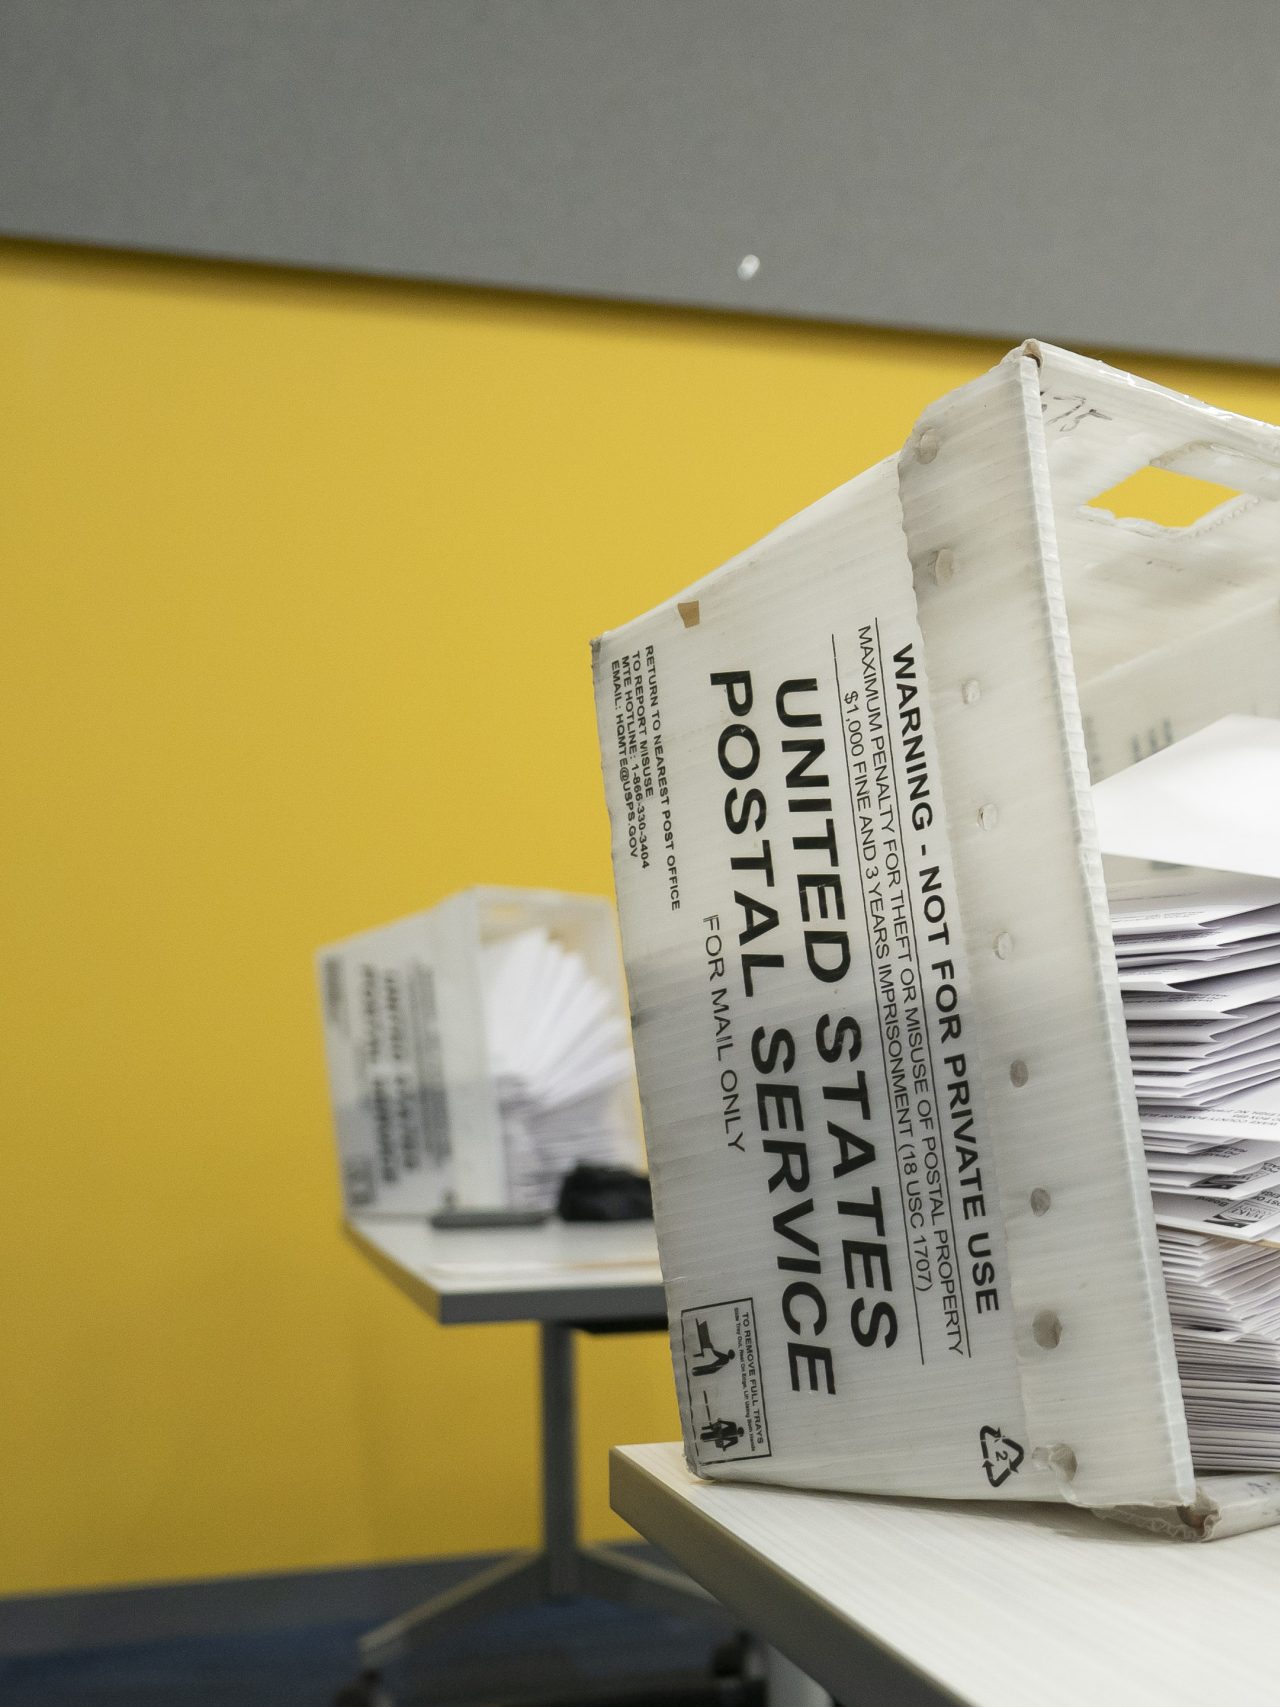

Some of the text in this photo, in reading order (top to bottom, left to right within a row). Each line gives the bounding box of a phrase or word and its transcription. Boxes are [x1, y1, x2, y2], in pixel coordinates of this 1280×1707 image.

[611, 660, 638, 858] EMAIL: HQMTE@USPS.GOV
[622, 655, 632, 687] MTE
[625, 690, 638, 760] HOTLINE:
[632, 650, 654, 798] TO REPORT MISUSE
[645, 645, 681, 911] RETURN TO NEAREST POST OFFICE
[703, 914, 745, 1152] FOR MAIL ONLY
[710, 670, 836, 1395] POSTAL SERVICE
[775, 678, 897, 1349] UNITED STATES
[844, 690, 933, 1292] $1,000 FINE AND 3 YEARS IMPRISONMENT (18 USC 1707)
[857, 625, 964, 1355] MAXIMUM PENALTY FOR THEFT OR MISUSE OF POSTAL PROPERTY
[893, 643, 1000, 1315] WARNING - NOT FOR PRIVATE USE
[742, 1312, 764, 1444] TO REMOVE FULL TRAYS
[995, 1450, 1009, 1462] 2
